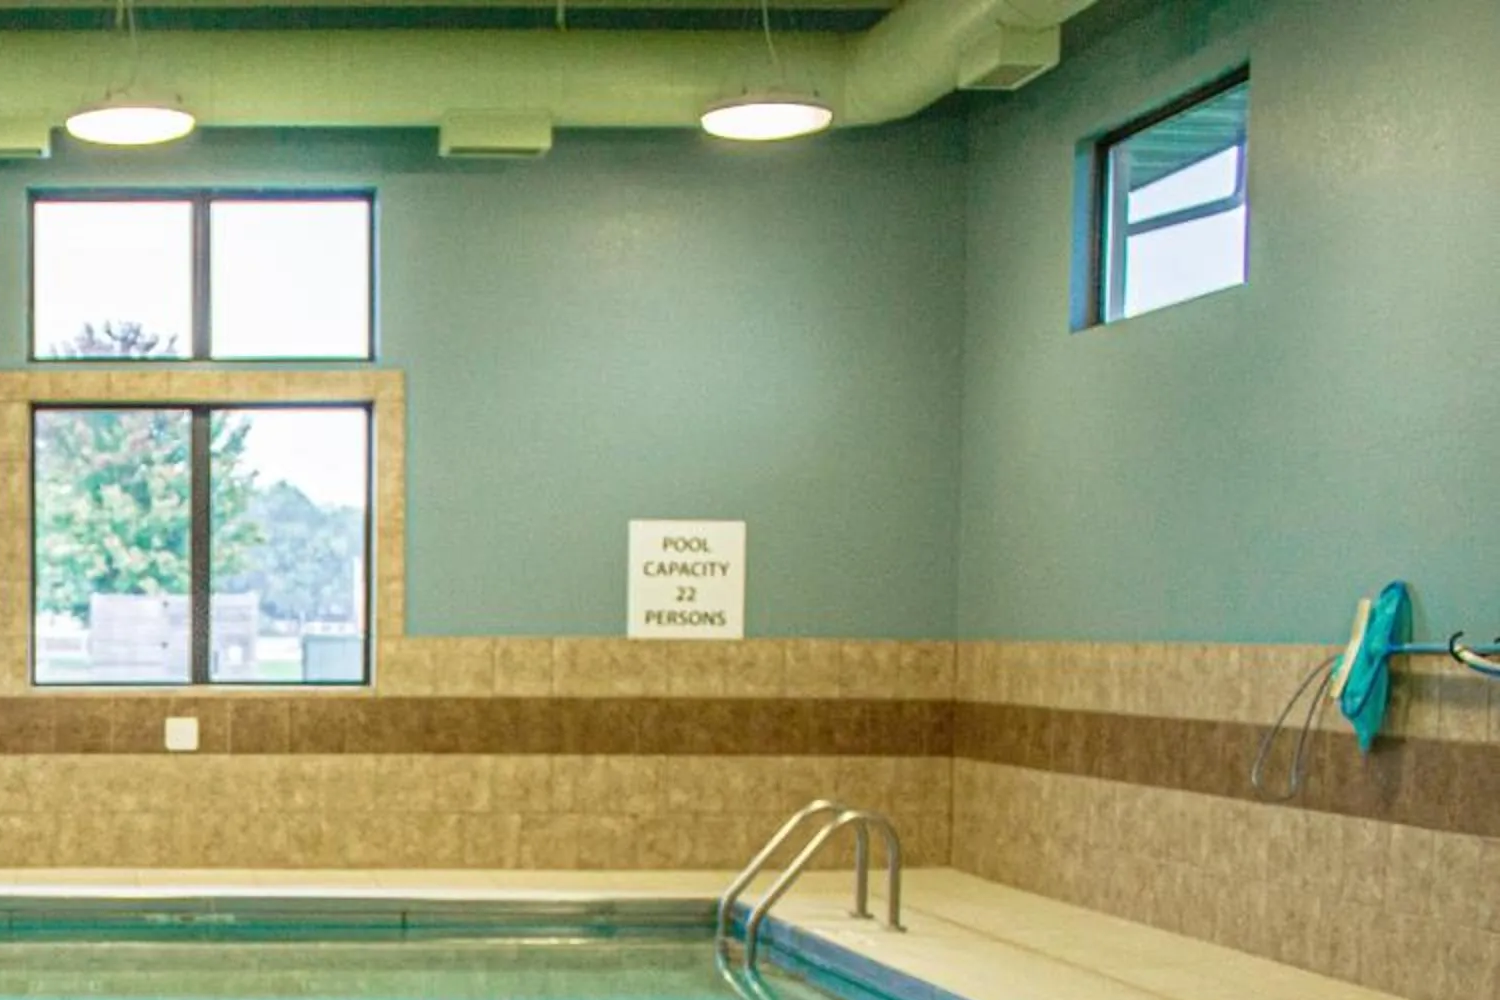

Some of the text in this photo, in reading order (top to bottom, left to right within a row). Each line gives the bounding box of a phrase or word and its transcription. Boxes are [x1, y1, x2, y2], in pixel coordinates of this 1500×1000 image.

[662, 536, 710, 553] POOL
[642, 560, 730, 577] CAPACITY
[675, 585, 698, 603] 22
[644, 608, 727, 627] PERSONS
